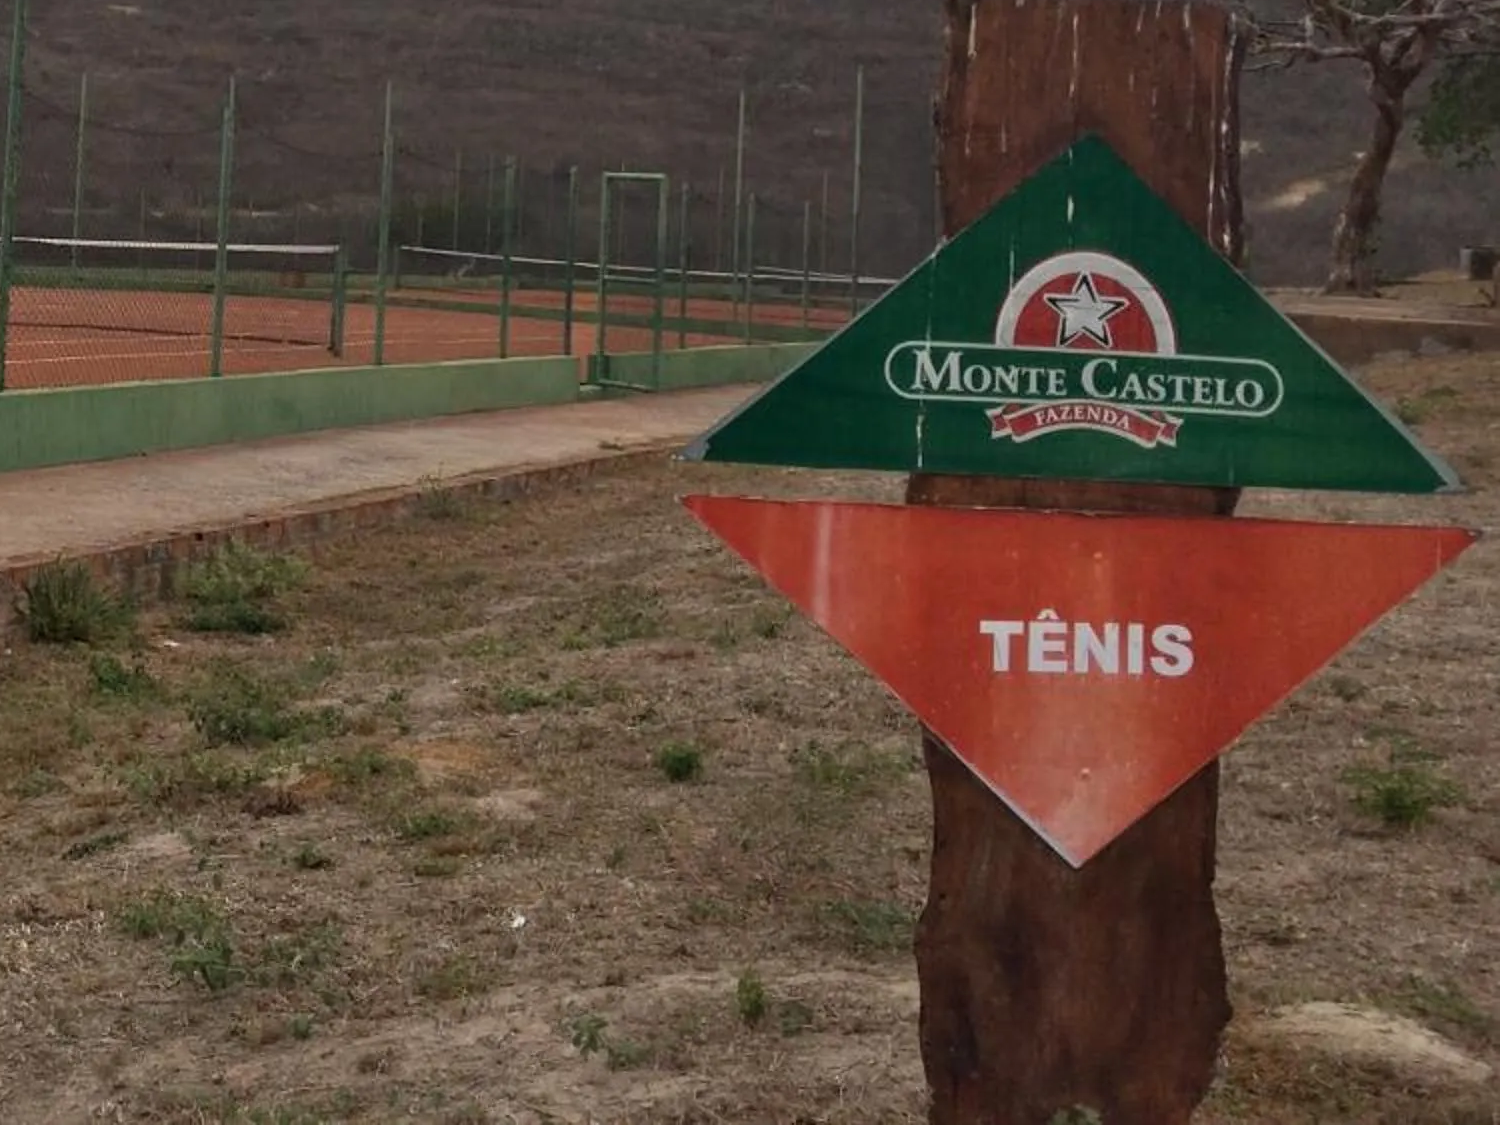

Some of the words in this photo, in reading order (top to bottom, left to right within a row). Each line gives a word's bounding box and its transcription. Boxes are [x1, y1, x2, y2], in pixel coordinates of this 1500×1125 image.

[911, 349, 1067, 395] MONTE
[1081, 358, 1266, 408] CASTELO
[1035, 405, 1131, 430] FAZENDA
[979, 608, 1195, 677] TÊNIS
